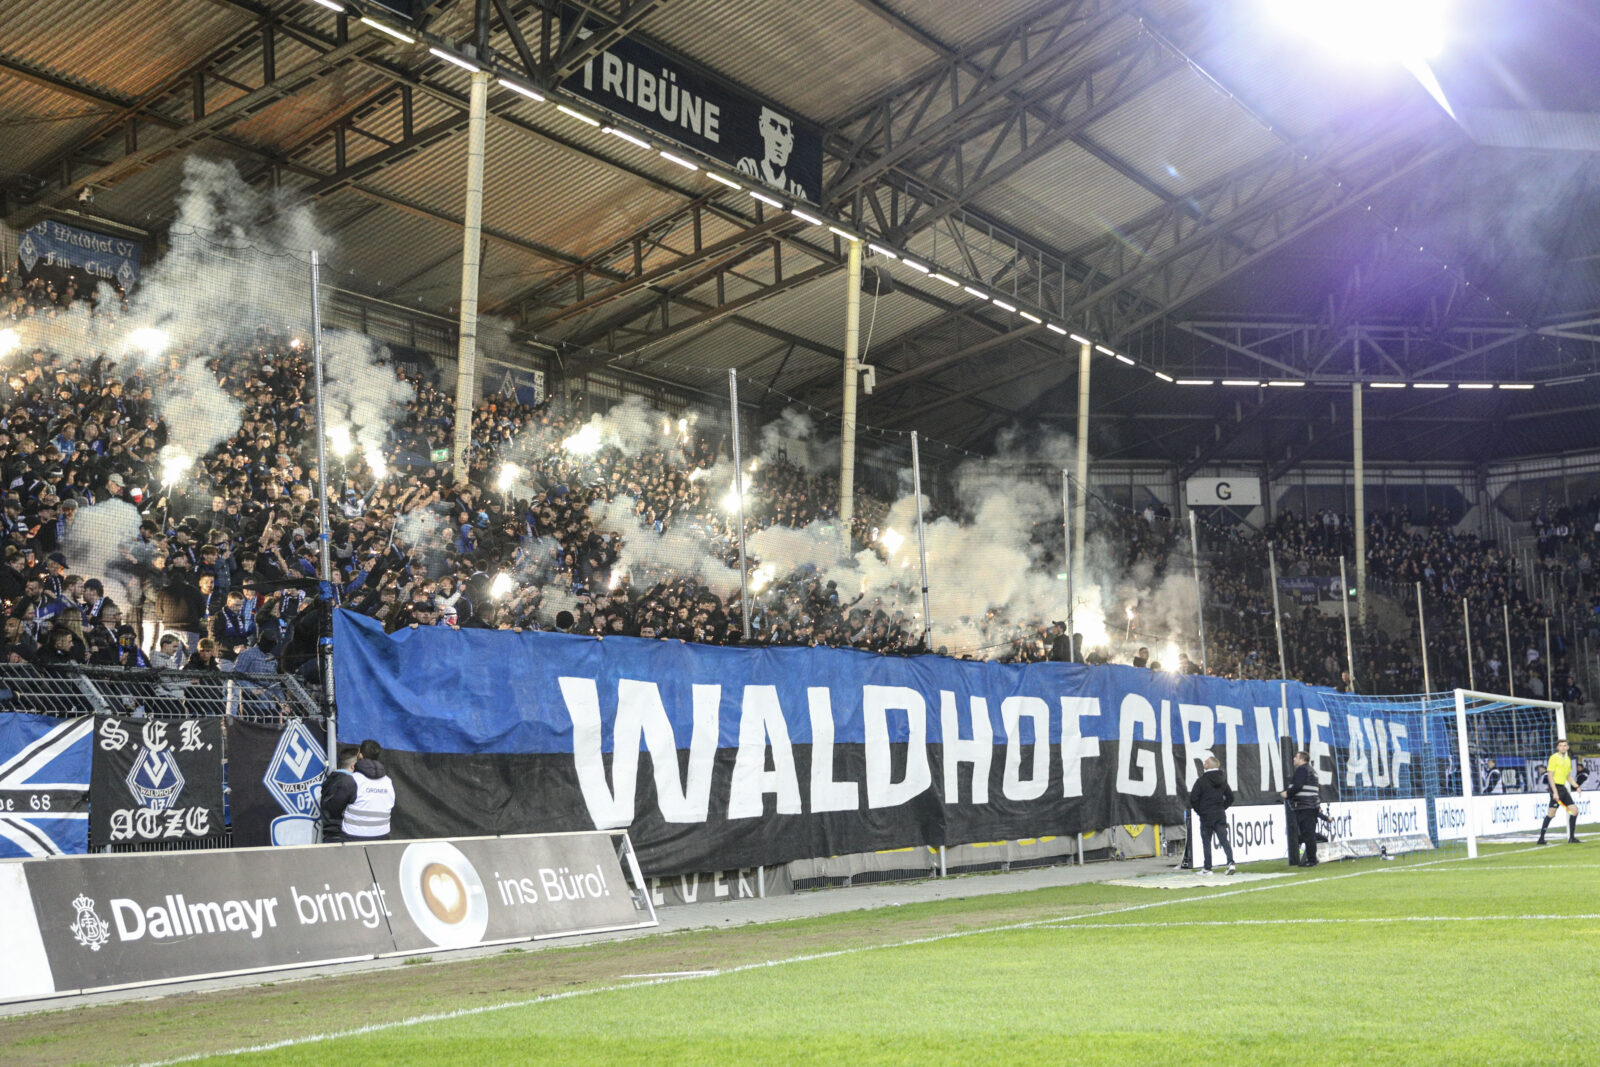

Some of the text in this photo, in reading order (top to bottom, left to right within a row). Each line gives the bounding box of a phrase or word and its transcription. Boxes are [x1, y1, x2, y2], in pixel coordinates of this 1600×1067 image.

[117, 241, 135, 257] 07
[43, 251, 71, 269] Fan
[85, 261, 114, 279] Club
[1216, 482, 1232, 500] G
[558, 677, 1411, 830] WALDHOF GIRT NIE AUF
[30, 794, 51, 811] 68
[141, 788, 173, 797] WALDHOF
[297, 793, 311, 811] 07
[110, 806, 210, 840] ATZE
[1377, 805, 1417, 833] uhlsport
[1438, 803, 1465, 834] uhlspo
[1492, 800, 1520, 828] uhlsport
[110, 864, 610, 941] Dallmayr bringt ins Büro!
